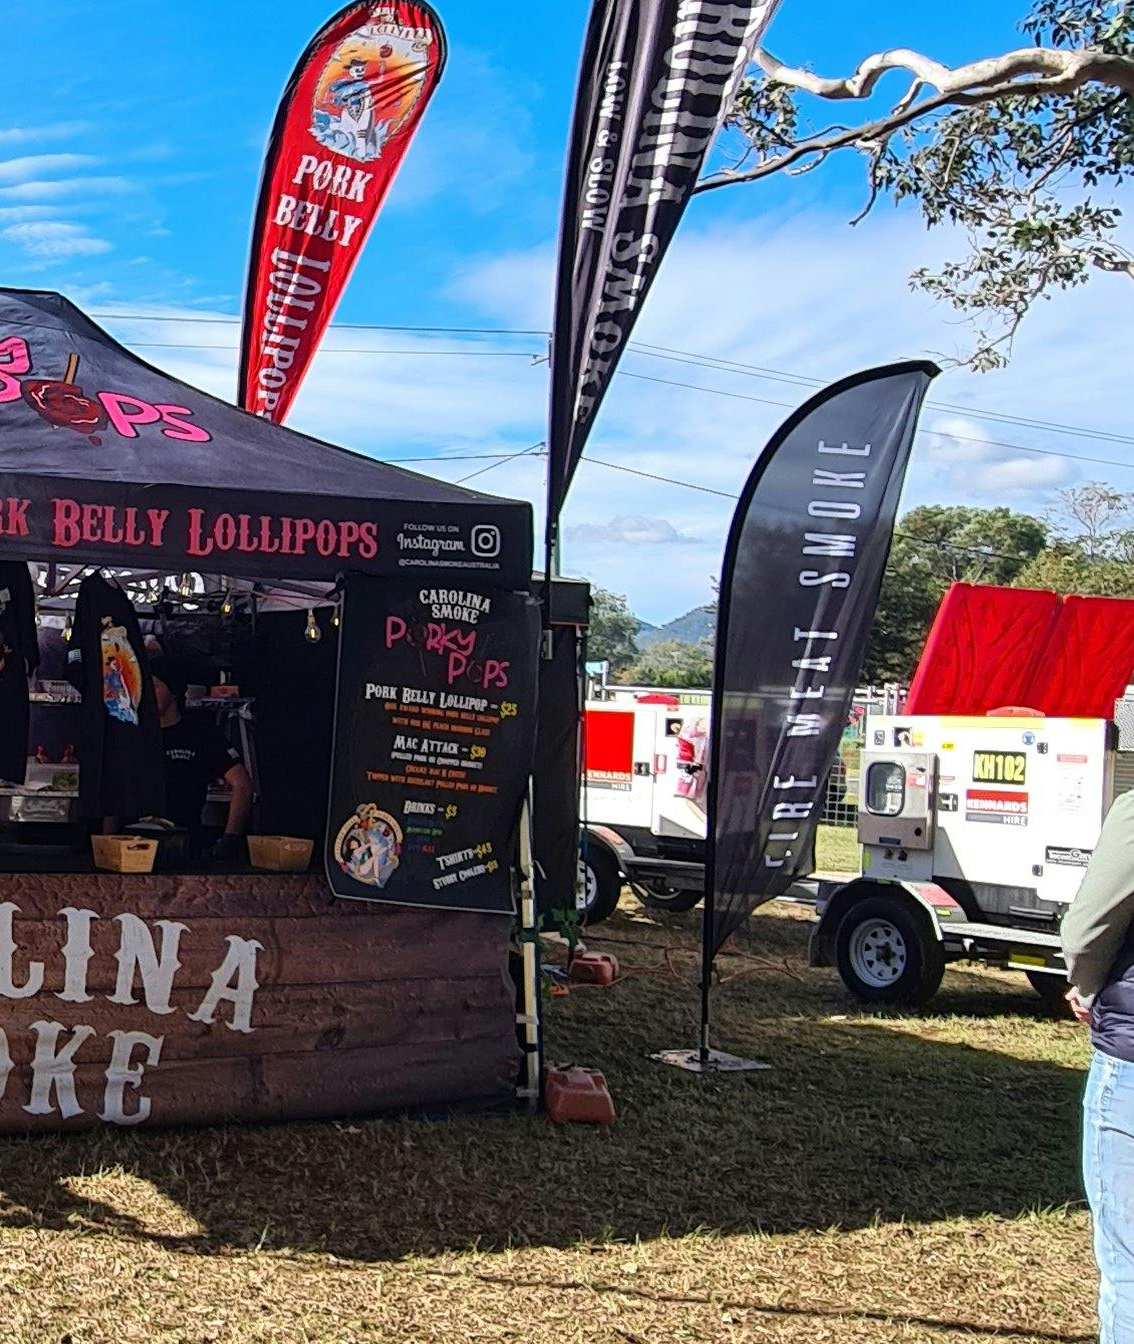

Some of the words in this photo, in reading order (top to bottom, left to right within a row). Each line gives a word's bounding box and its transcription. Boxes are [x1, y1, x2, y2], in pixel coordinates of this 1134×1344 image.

[599, 61, 628, 121] LOW
[292, 155, 374, 203] PORK
[582, 157, 614, 233] SLOW
[273, 193, 363, 247] BELLY
[52, 498, 170, 547] BELLY
[186, 508, 379, 558] LOLLIPOPS
[404, 523, 435, 532] FOLLOW
[447, 525, 460, 533] ON
[799, 440, 871, 588] SMOKE
[397, 533, 465, 556] Instagram
[398, 559, 500, 569] @CAROLINASMOKEAUSTRALIA
[419, 589, 492, 613] CAROLINA
[431, 604, 479, 624] SMOKE
[786, 627, 839, 736] MEAT
[365, 683, 398, 700] PORK
[402, 687, 436, 705] BELLY
[439, 692, 488, 711] LOLLIPOP
[393, 735, 418, 750] MAC
[420, 738, 459, 755] ATTACK
[974, 753, 1025, 781] KH102
[967, 798, 1027, 812] KENNARDS
[1003, 816, 1026, 826] HIRE
